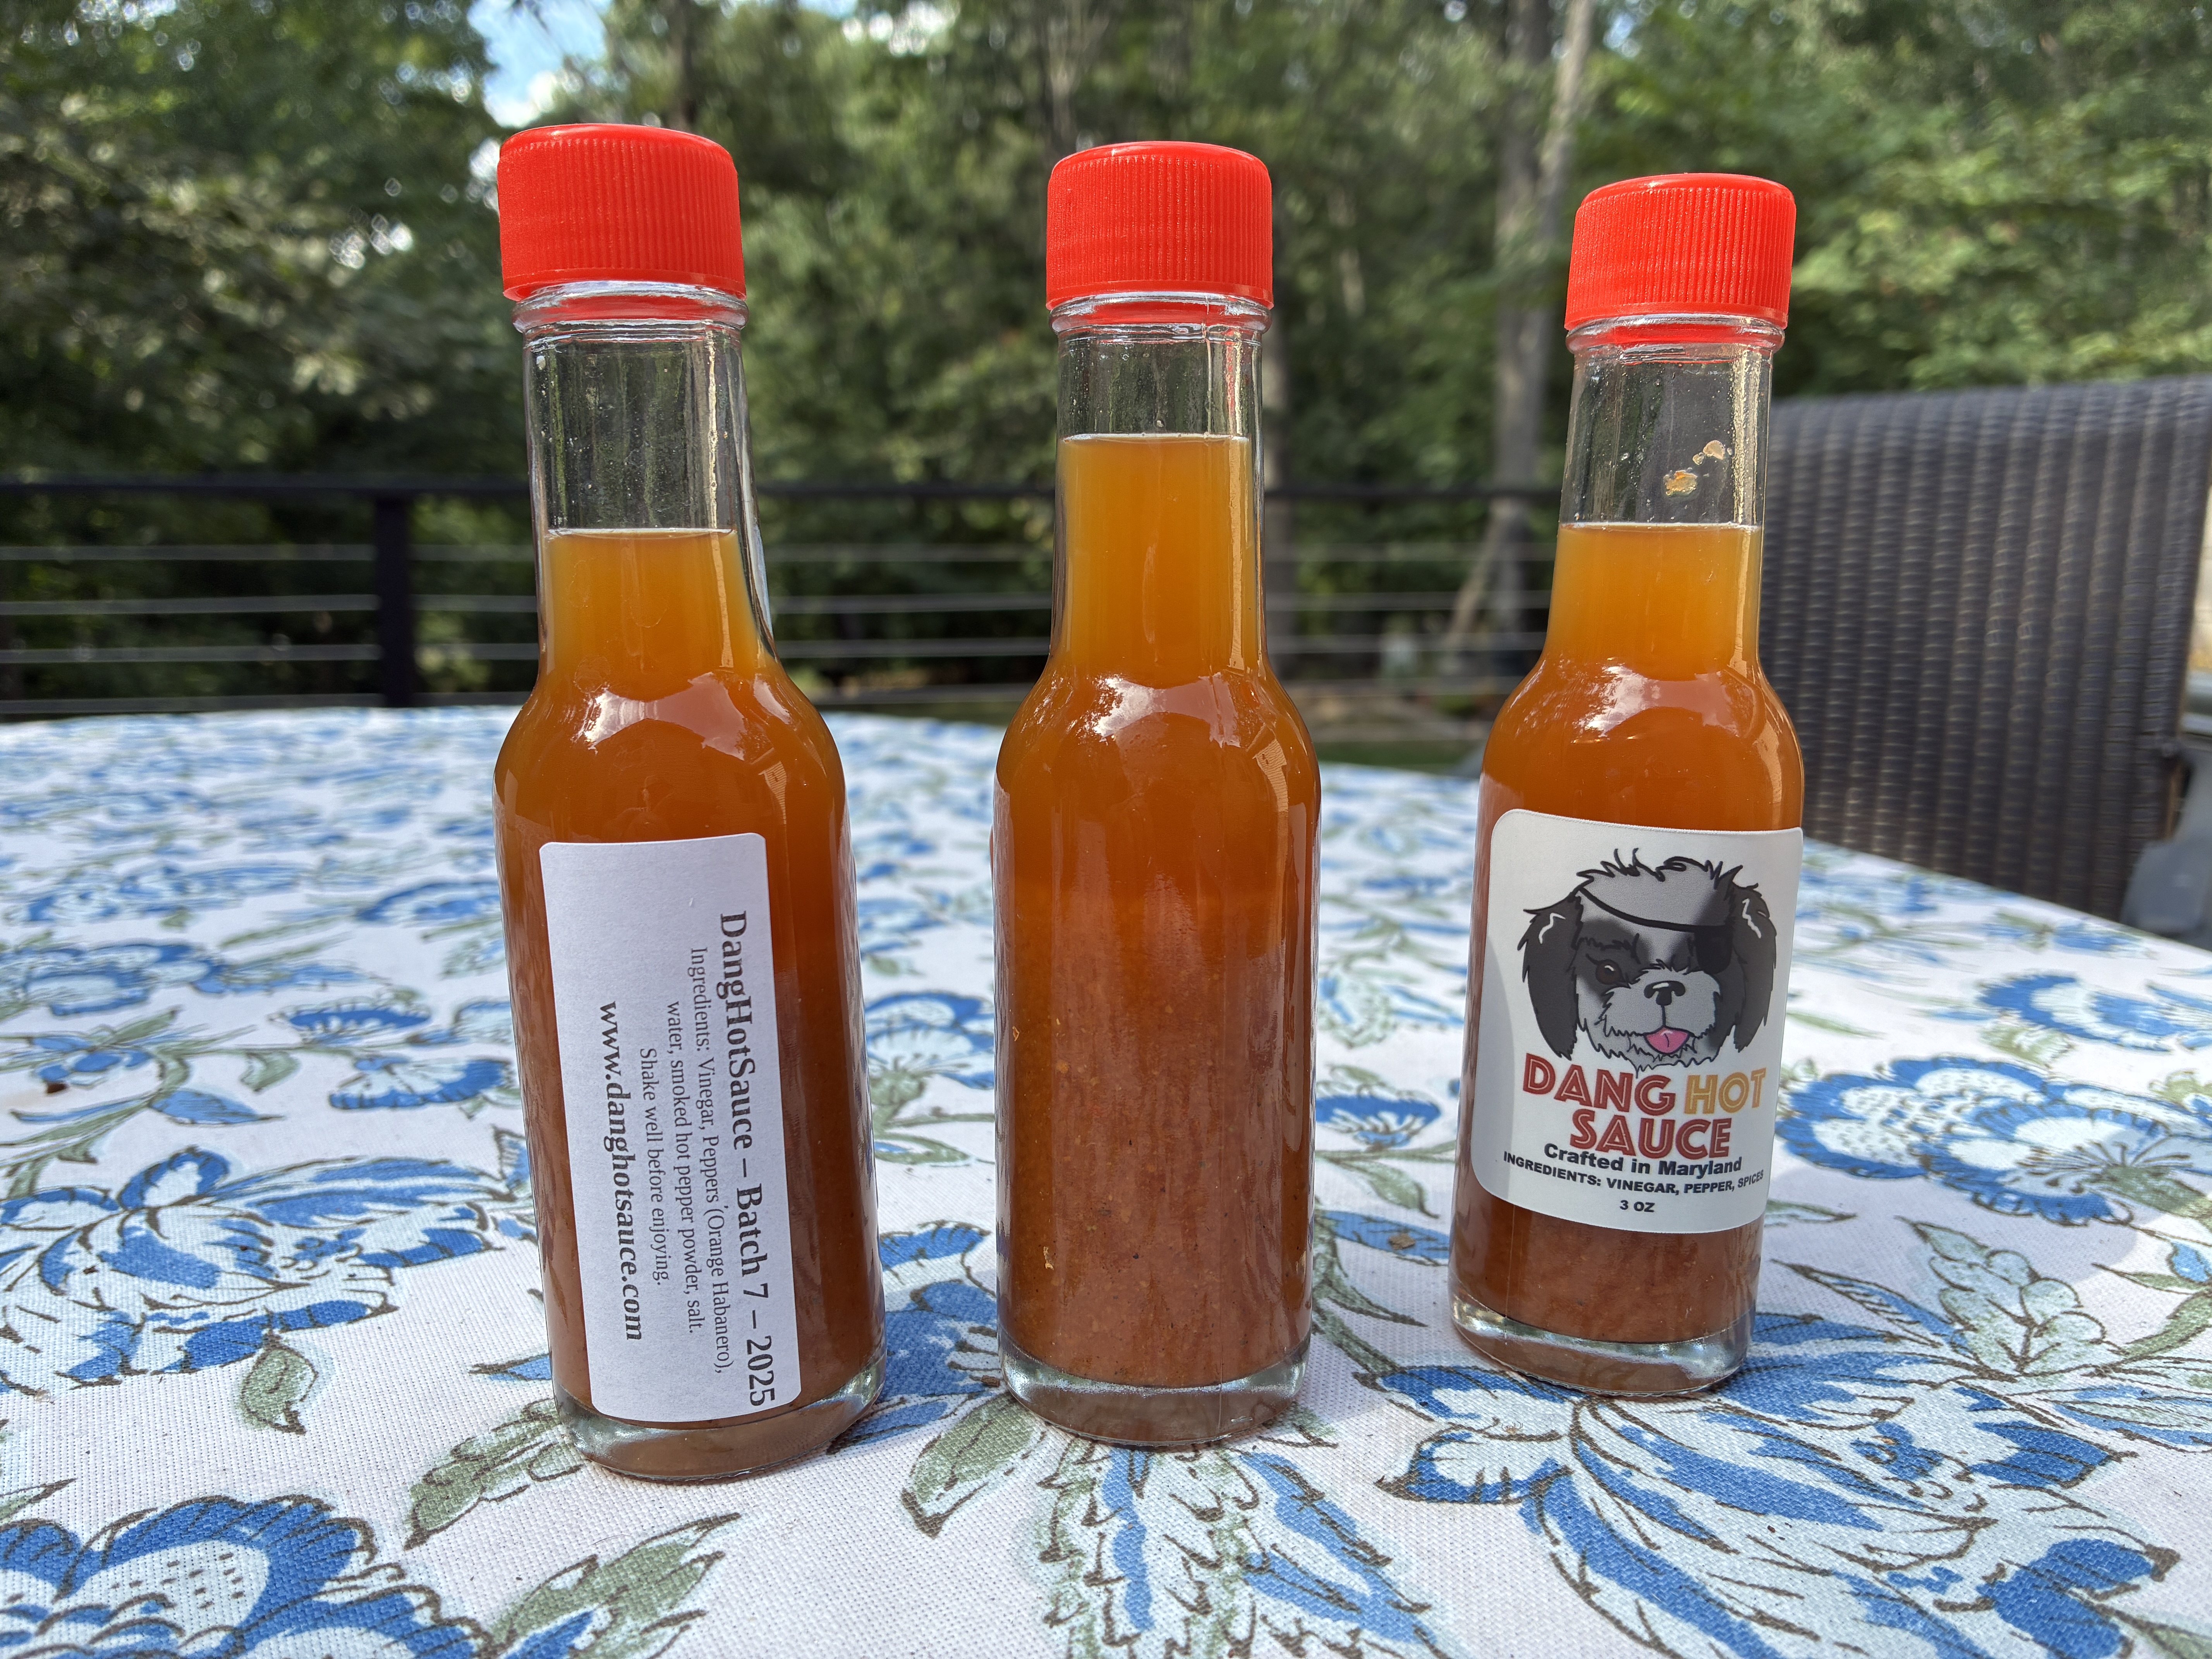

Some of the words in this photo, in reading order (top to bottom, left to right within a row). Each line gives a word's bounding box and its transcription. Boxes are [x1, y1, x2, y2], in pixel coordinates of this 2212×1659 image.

[667, 1001, 683, 1054] water,
[688, 947, 711, 1051] Ingredients:
[716, 911, 755, 1150] DangHotSauce
[640, 1049, 659, 1100] Shake
[671, 1060, 692, 1127] smoked
[696, 1057, 715, 1130] Vinegar,
[1523, 1053, 1676, 1116] DANG
[1684, 1067, 1767, 1115] HOT
[645, 1106, 663, 1142] well
[676, 1132, 692, 1160] hot
[1570, 1108, 1733, 1159] SAUCE
[600, 1001, 642, 1340] www.danghotsauce.com
[647, 1148, 666, 1202] before
[699, 1135, 719, 1202] Peppers
[1503, 1151, 1601, 1187] INGREDIENTS:
[1607, 1178, 1680, 1195] VINEGAR,
[1684, 1181, 1735, 1194] PEPPER,
[1737, 1170, 1764, 1188] SPICES
[1544, 1143, 1623, 1172] Crafted
[1632, 1158, 1650, 1175] in
[1659, 1157, 1742, 1180] Maryland
[673, 1165, 694, 1223] pepper
[1620, 1200, 1628, 1211] 3
[1633, 1201, 1655, 1213] OZ
[649, 1208, 672, 1285] enjoying.
[678, 1228, 702, 1294] powder,
[703, 1209, 724, 1276] (Orange
[737, 1183, 767, 1277] Batch
[687, 1300, 705, 1333] salt.
[743, 1283, 768, 1298] 7
[713, 1281, 734, 1373] Habanero),
[747, 1336, 775, 1406] 2025
